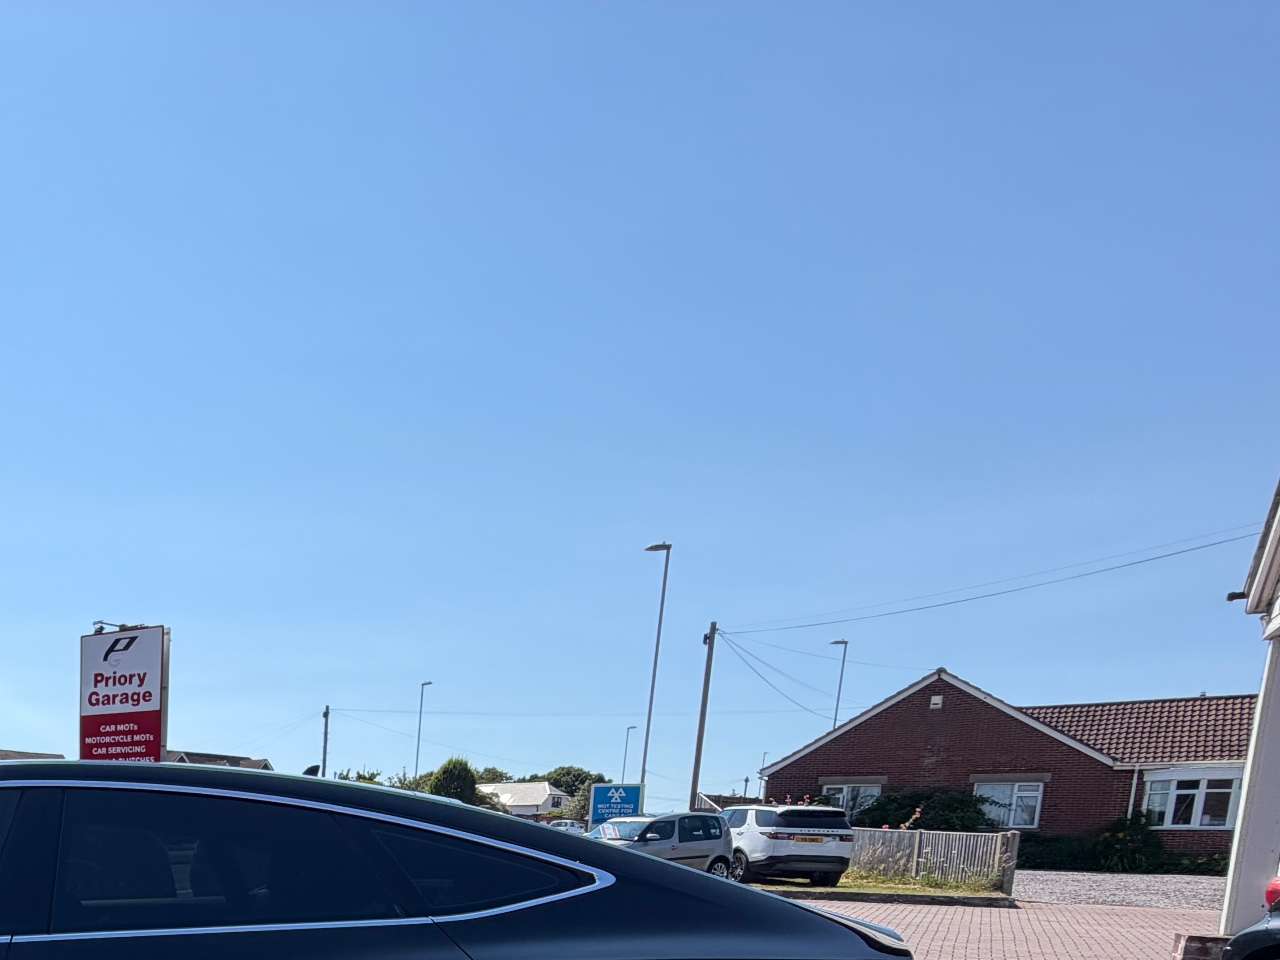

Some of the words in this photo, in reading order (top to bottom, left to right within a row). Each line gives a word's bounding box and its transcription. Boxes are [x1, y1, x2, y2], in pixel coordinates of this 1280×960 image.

[93, 671, 147, 688] Priory
[88, 690, 153, 707] Garage
[100, 724, 116, 732] CAR
[117, 723, 138, 731] MOTs
[85, 735, 132, 744] MOTORCYCLE
[133, 733, 154, 741] MOTs
[92, 747, 107, 755] CAR
[108, 745, 146, 754] SERVICING
